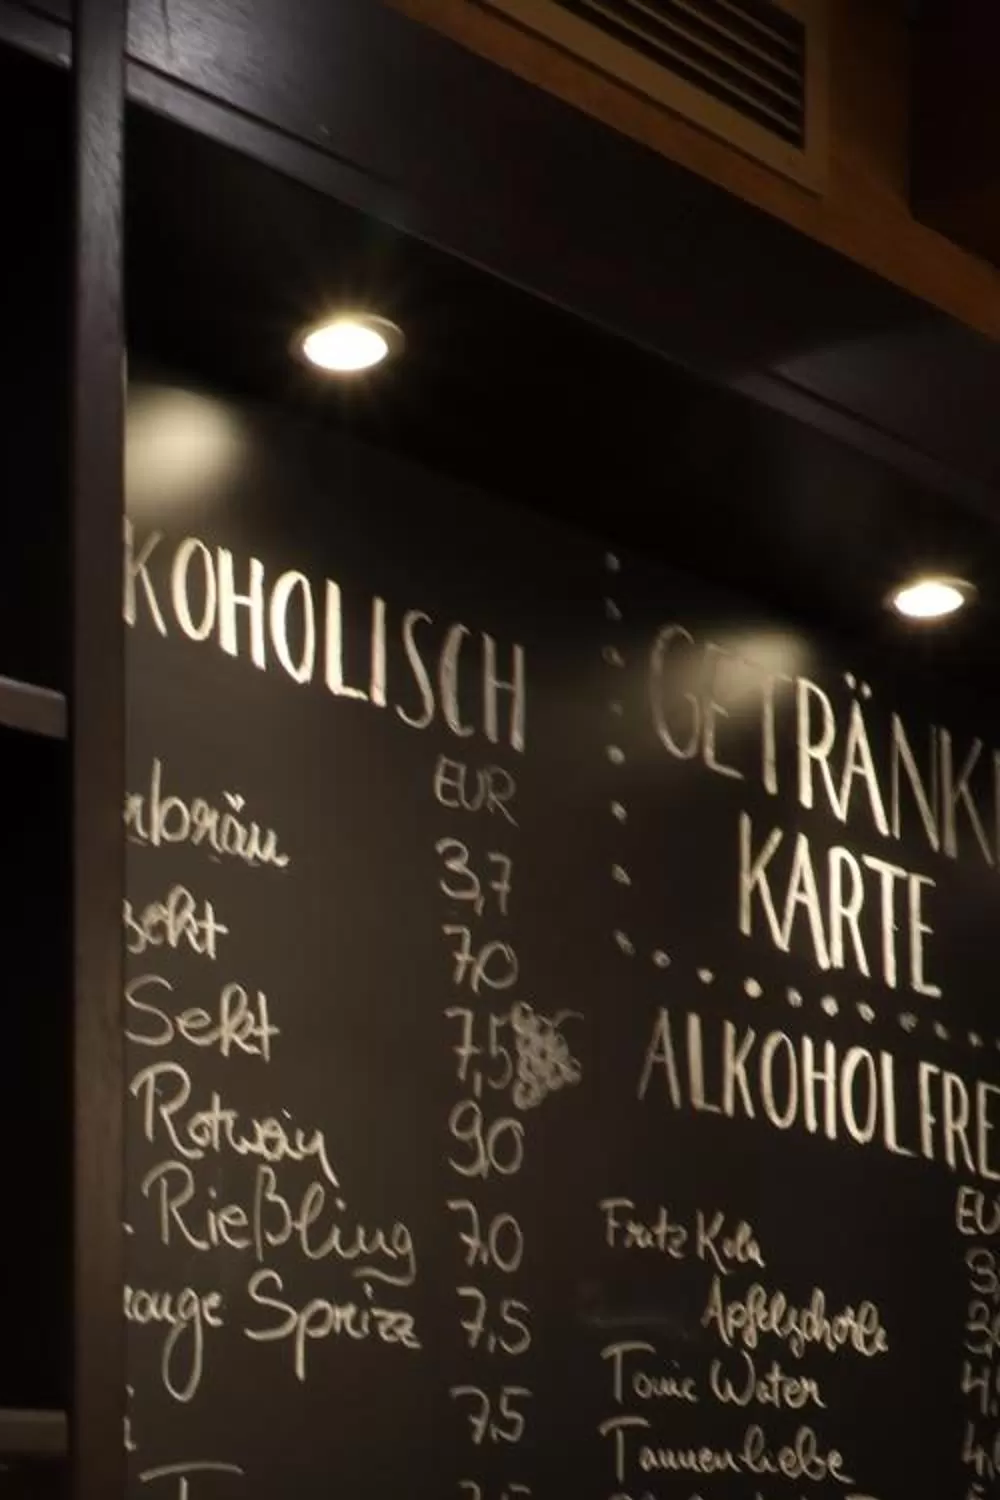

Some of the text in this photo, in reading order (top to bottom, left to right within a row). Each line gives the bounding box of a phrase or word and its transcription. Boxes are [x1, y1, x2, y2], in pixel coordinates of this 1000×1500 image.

[648, 622, 1000, 874] GETRÄNK
[434, 754, 520, 828] EUR
[738, 809, 943, 999] KARTE
[123, 974, 281, 1063] Sekt
[456, 1286, 533, 1356] 7,5
[711, 1349, 827, 1409] Water
